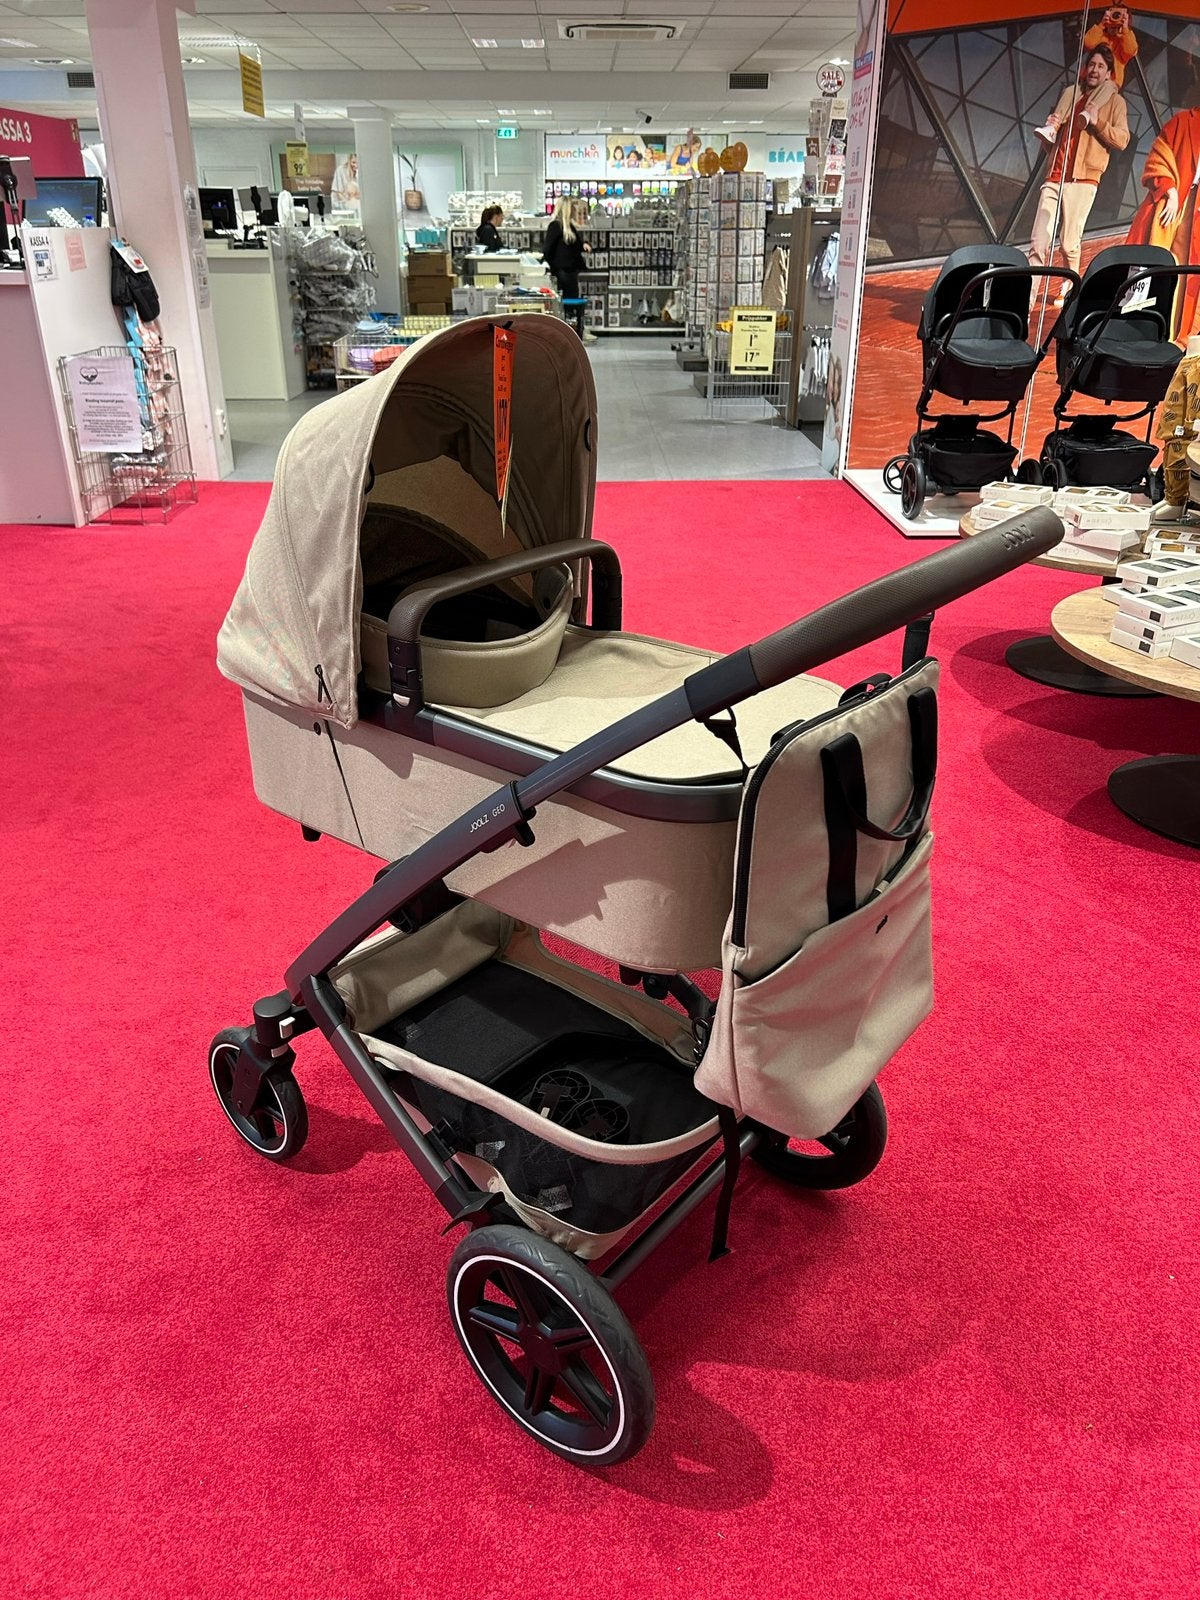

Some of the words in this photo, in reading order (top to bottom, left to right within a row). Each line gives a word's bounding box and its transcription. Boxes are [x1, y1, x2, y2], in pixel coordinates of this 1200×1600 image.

[821, 70, 841, 80] SALE
[24, 121, 32, 144] 3
[550, 143, 599, 158] munchkin
[29, 236, 45, 247] KASSA
[1001, 524, 1035, 551] JOOLZ
[470, 814, 489, 833] JOOLZ
[491, 803, 506, 817] GEO
